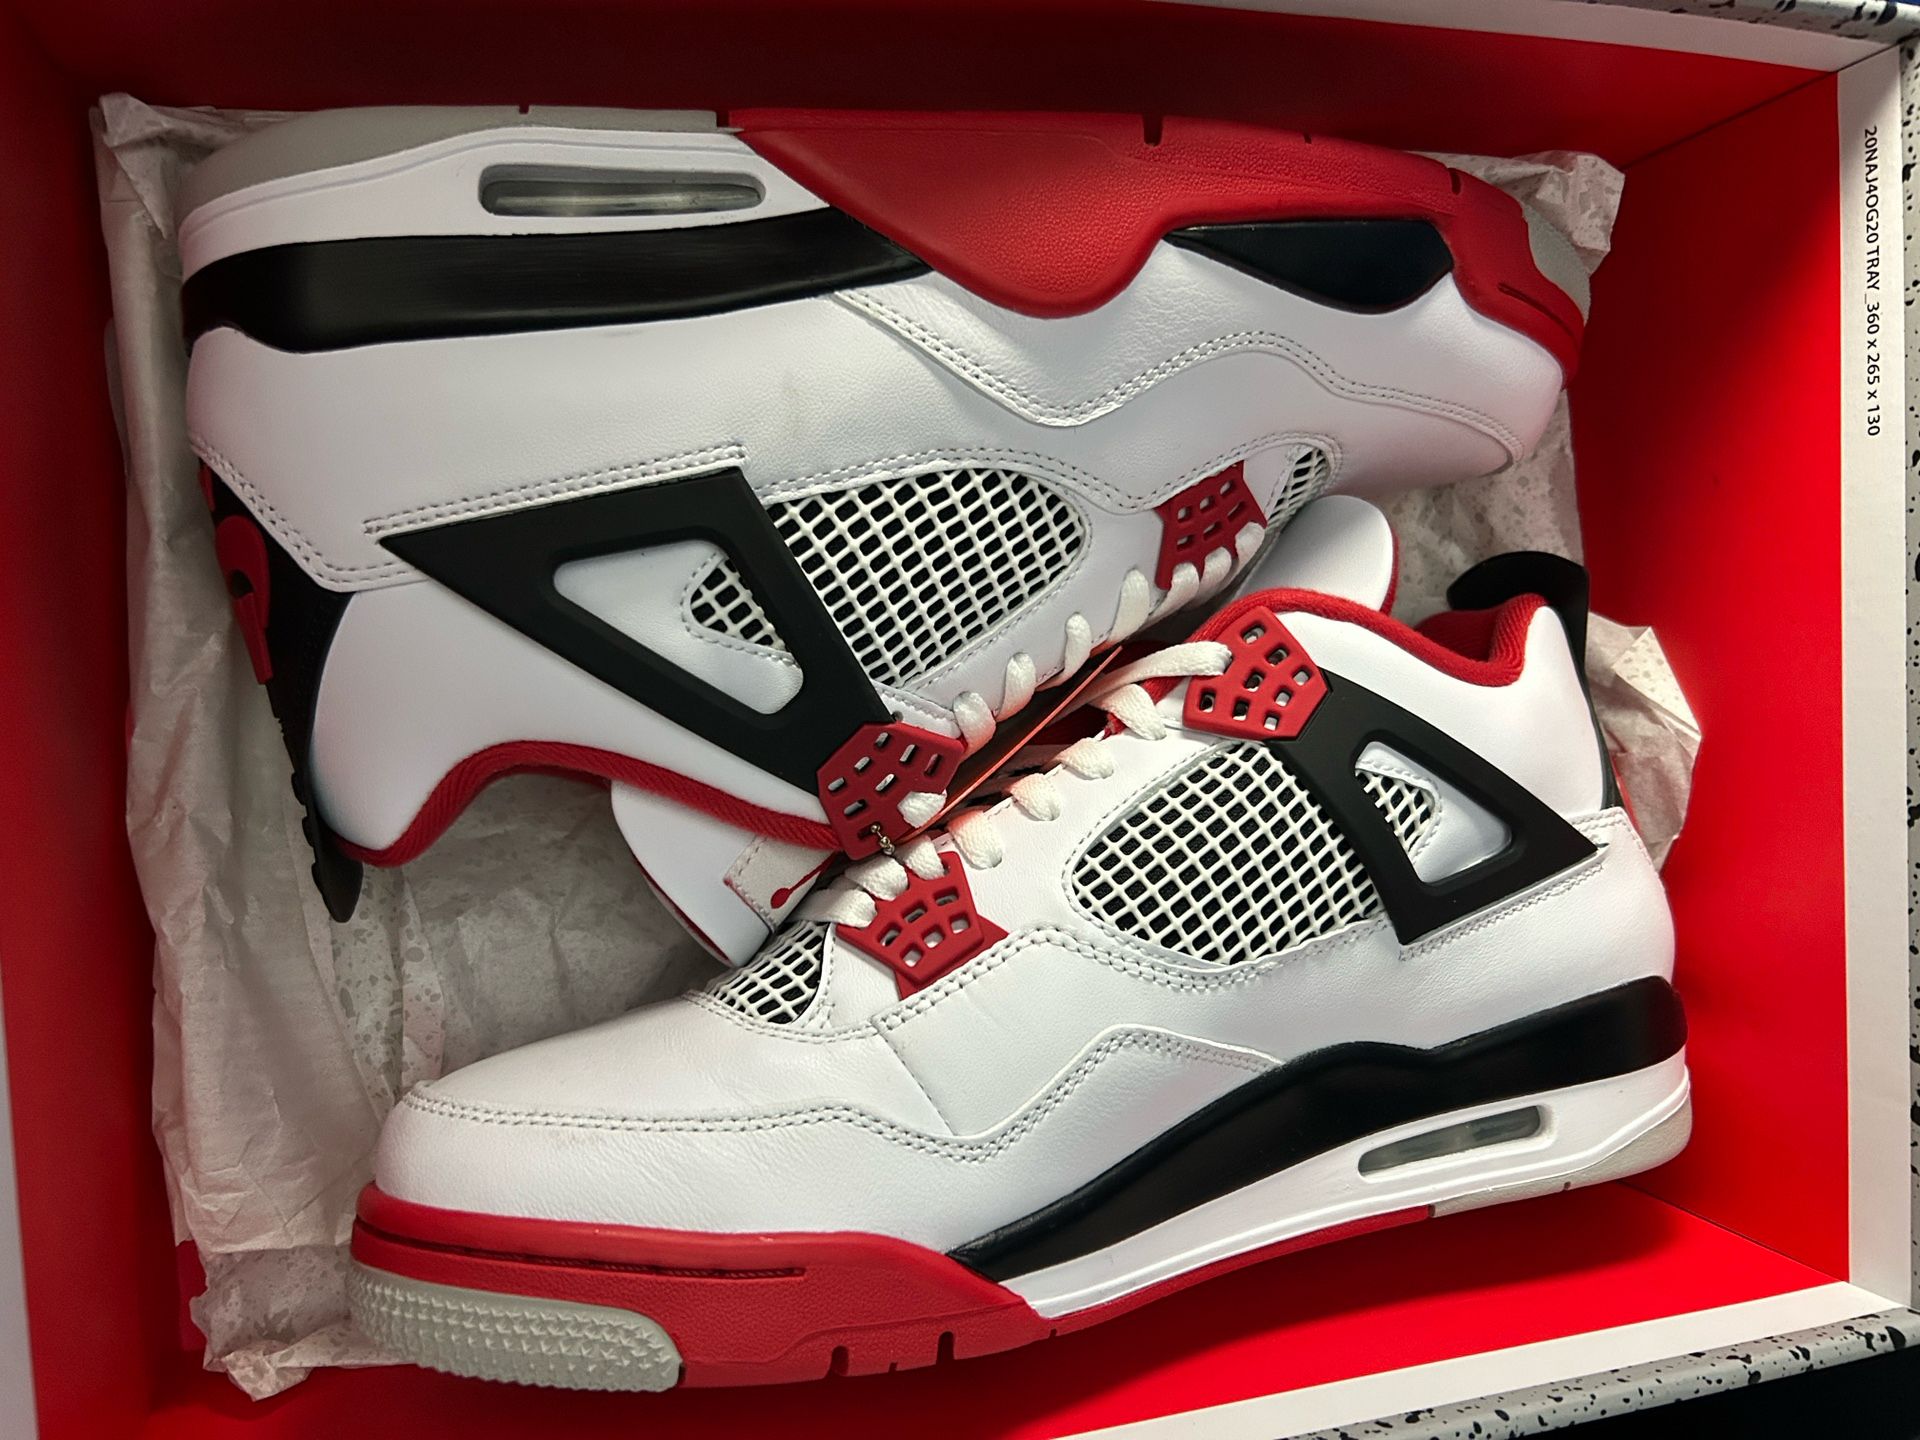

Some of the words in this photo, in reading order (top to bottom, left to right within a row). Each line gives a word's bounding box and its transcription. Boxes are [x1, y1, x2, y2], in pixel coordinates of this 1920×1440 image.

[1866, 245, 1880, 290] TRAY
[1867, 338, 1877, 349] x
[1867, 353, 1880, 385] 265
[1867, 389, 1877, 400] x
[1867, 404, 1880, 436] 130
